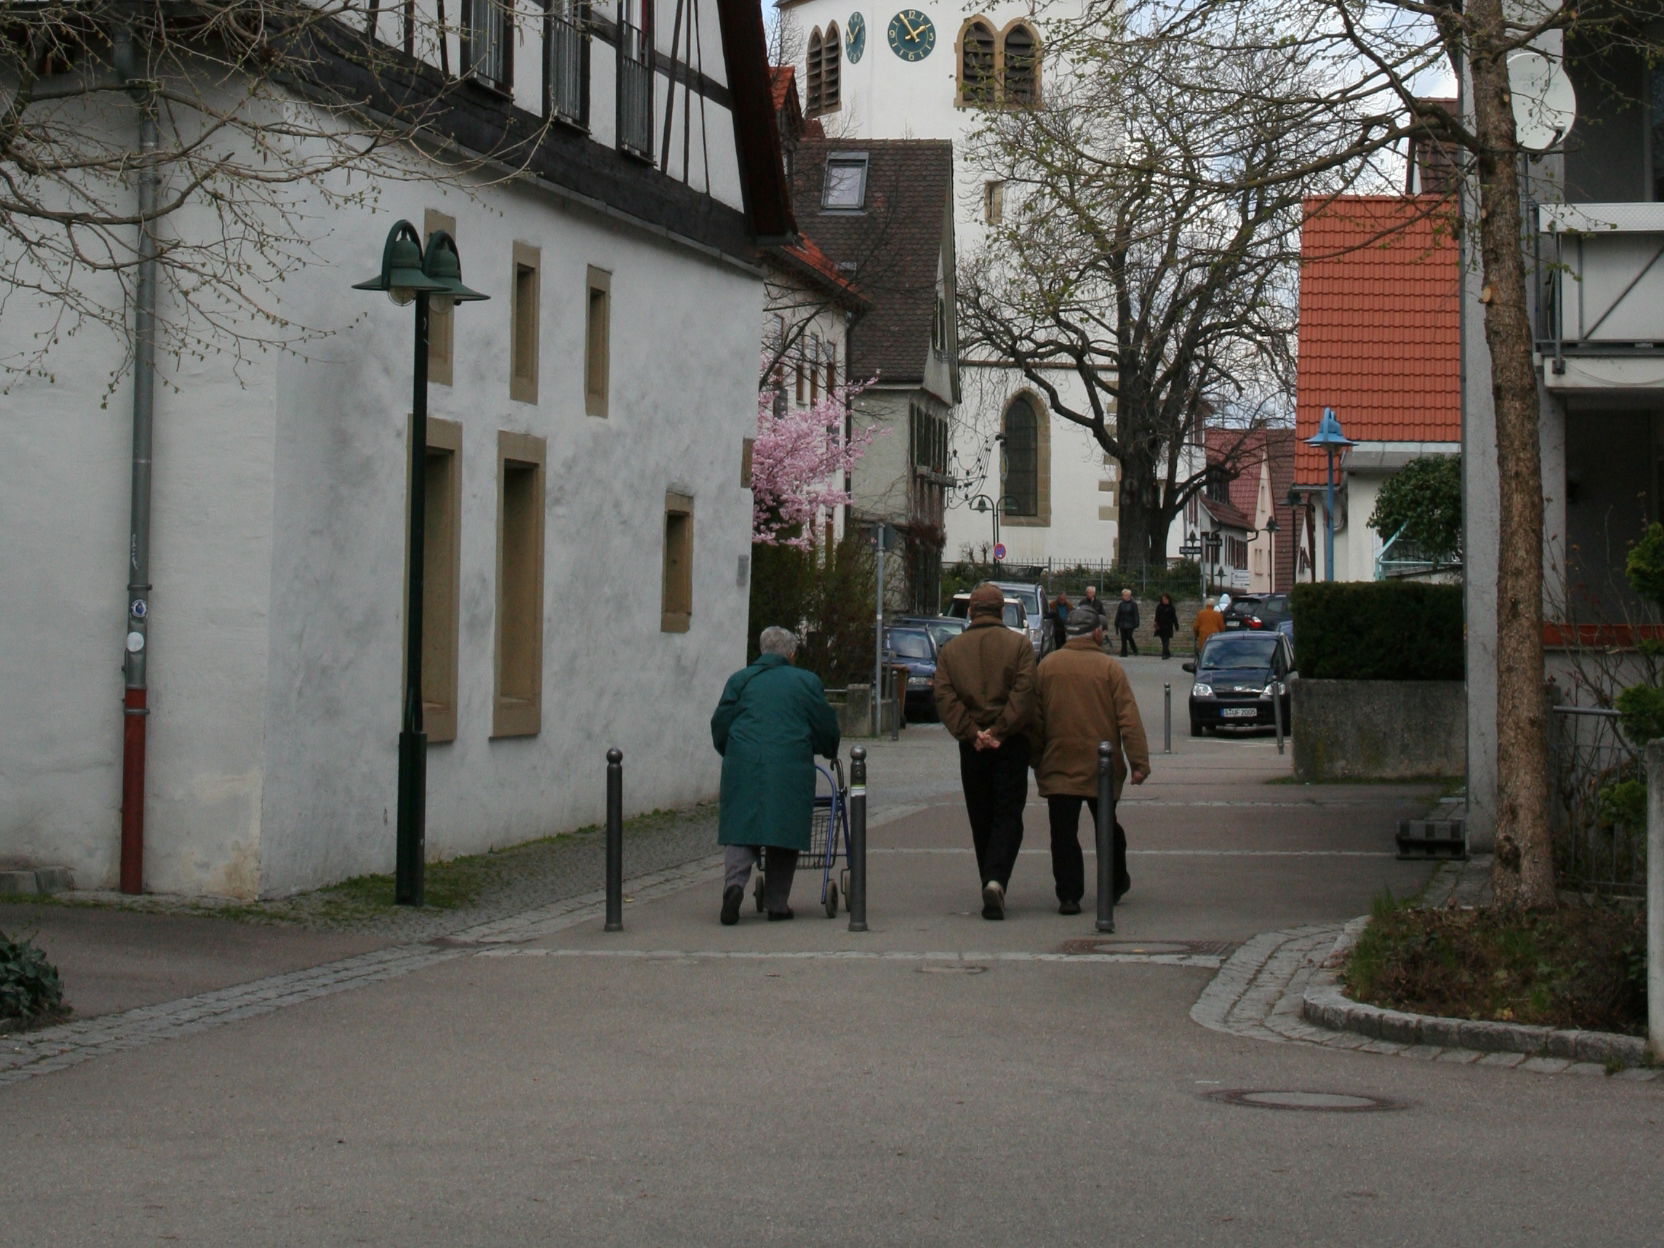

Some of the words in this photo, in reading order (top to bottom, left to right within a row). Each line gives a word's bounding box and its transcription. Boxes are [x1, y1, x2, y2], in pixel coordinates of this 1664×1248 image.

[908, 10, 916, 18] 12
[889, 30, 896, 38] 9
[928, 32, 934, 40] 3
[908, 52, 914, 60] 6
